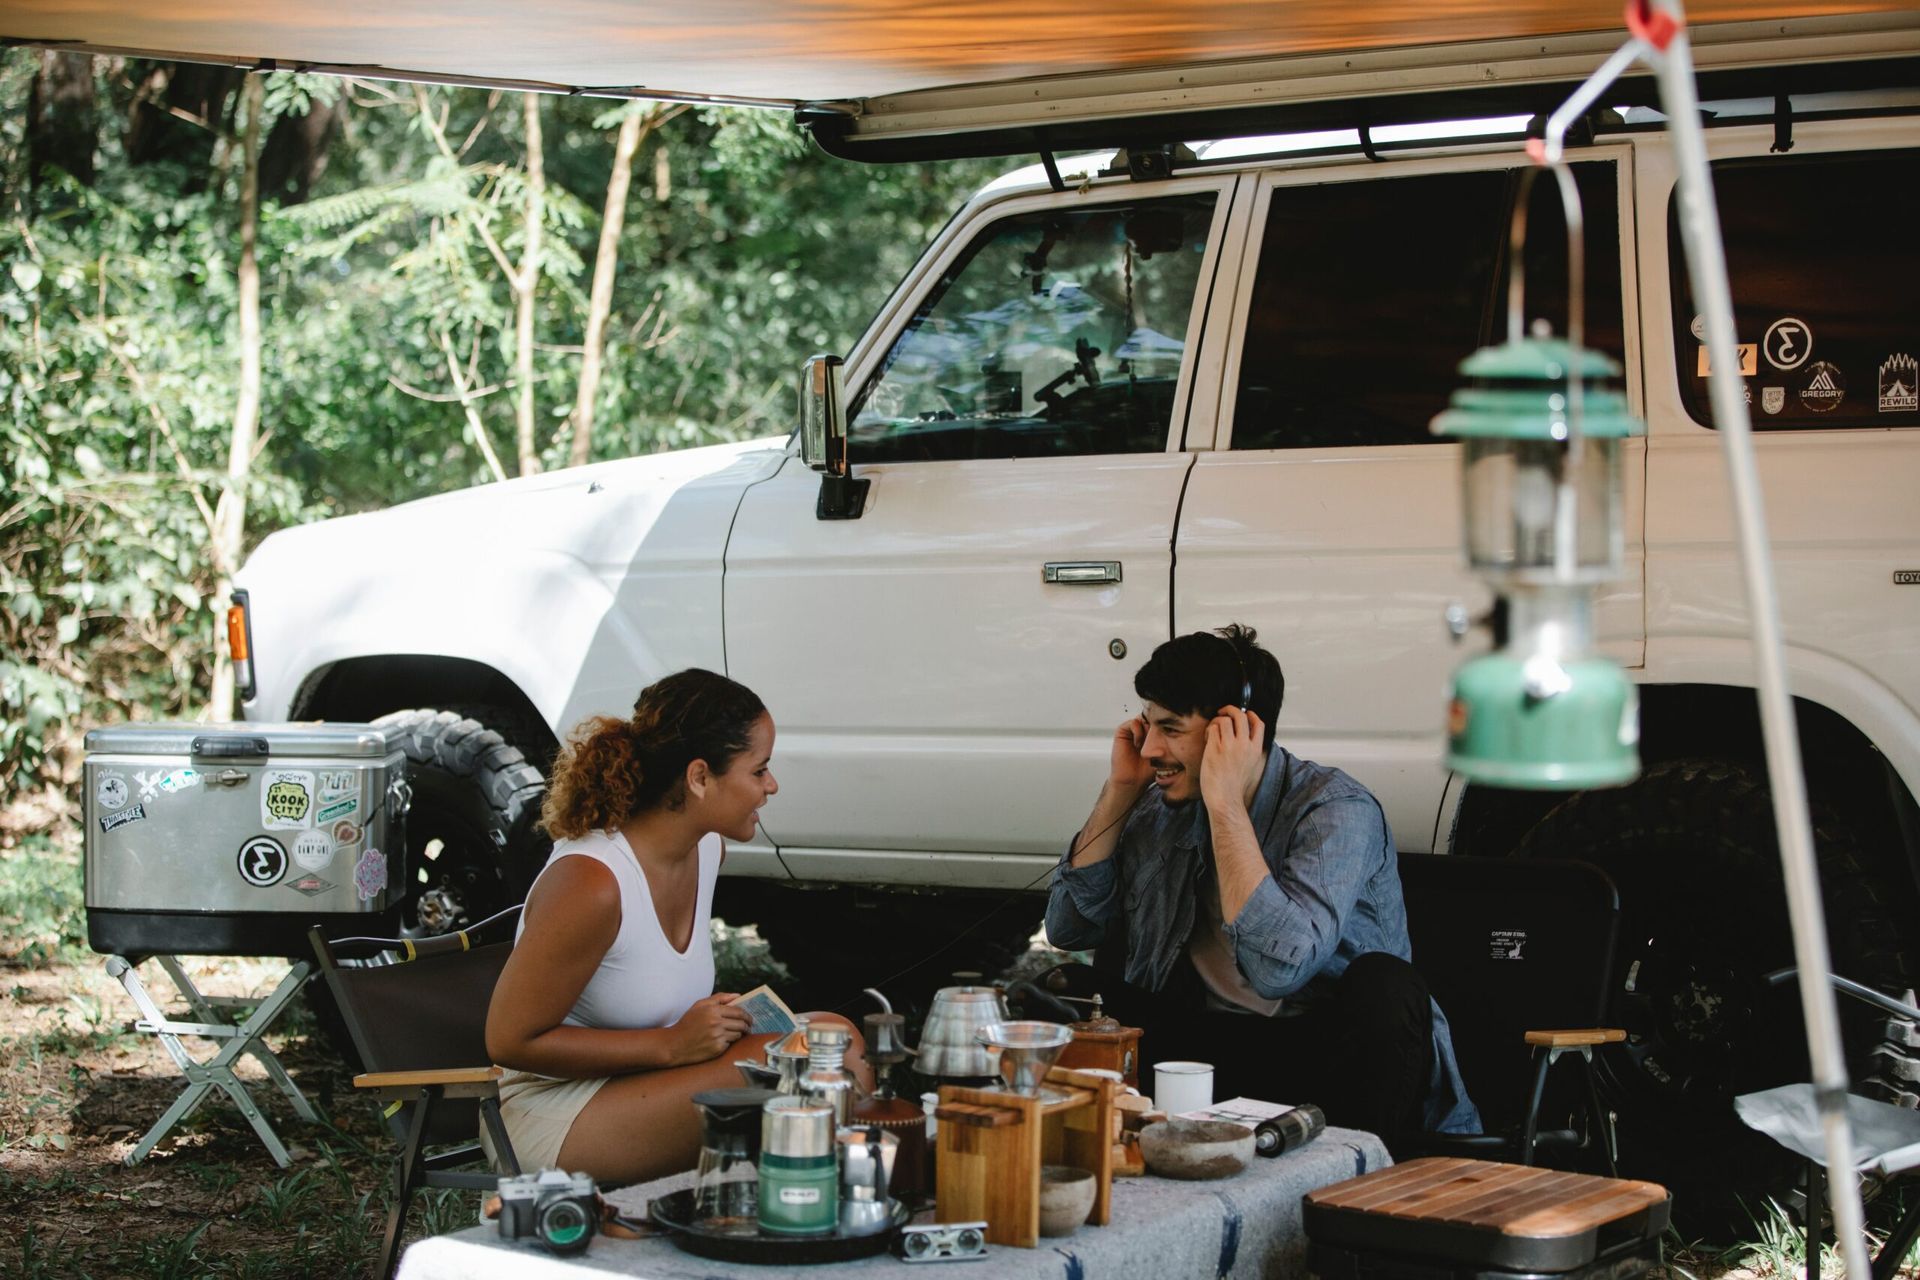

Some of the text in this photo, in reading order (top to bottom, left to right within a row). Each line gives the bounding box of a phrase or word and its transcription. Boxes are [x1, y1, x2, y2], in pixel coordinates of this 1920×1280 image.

[1801, 390, 1842, 398] GREGORY
[1880, 397, 1917, 406] REWILD
[1896, 573, 1920, 582] TOY
[271, 794, 305, 806] KOOK
[274, 805, 302, 815] CITY
